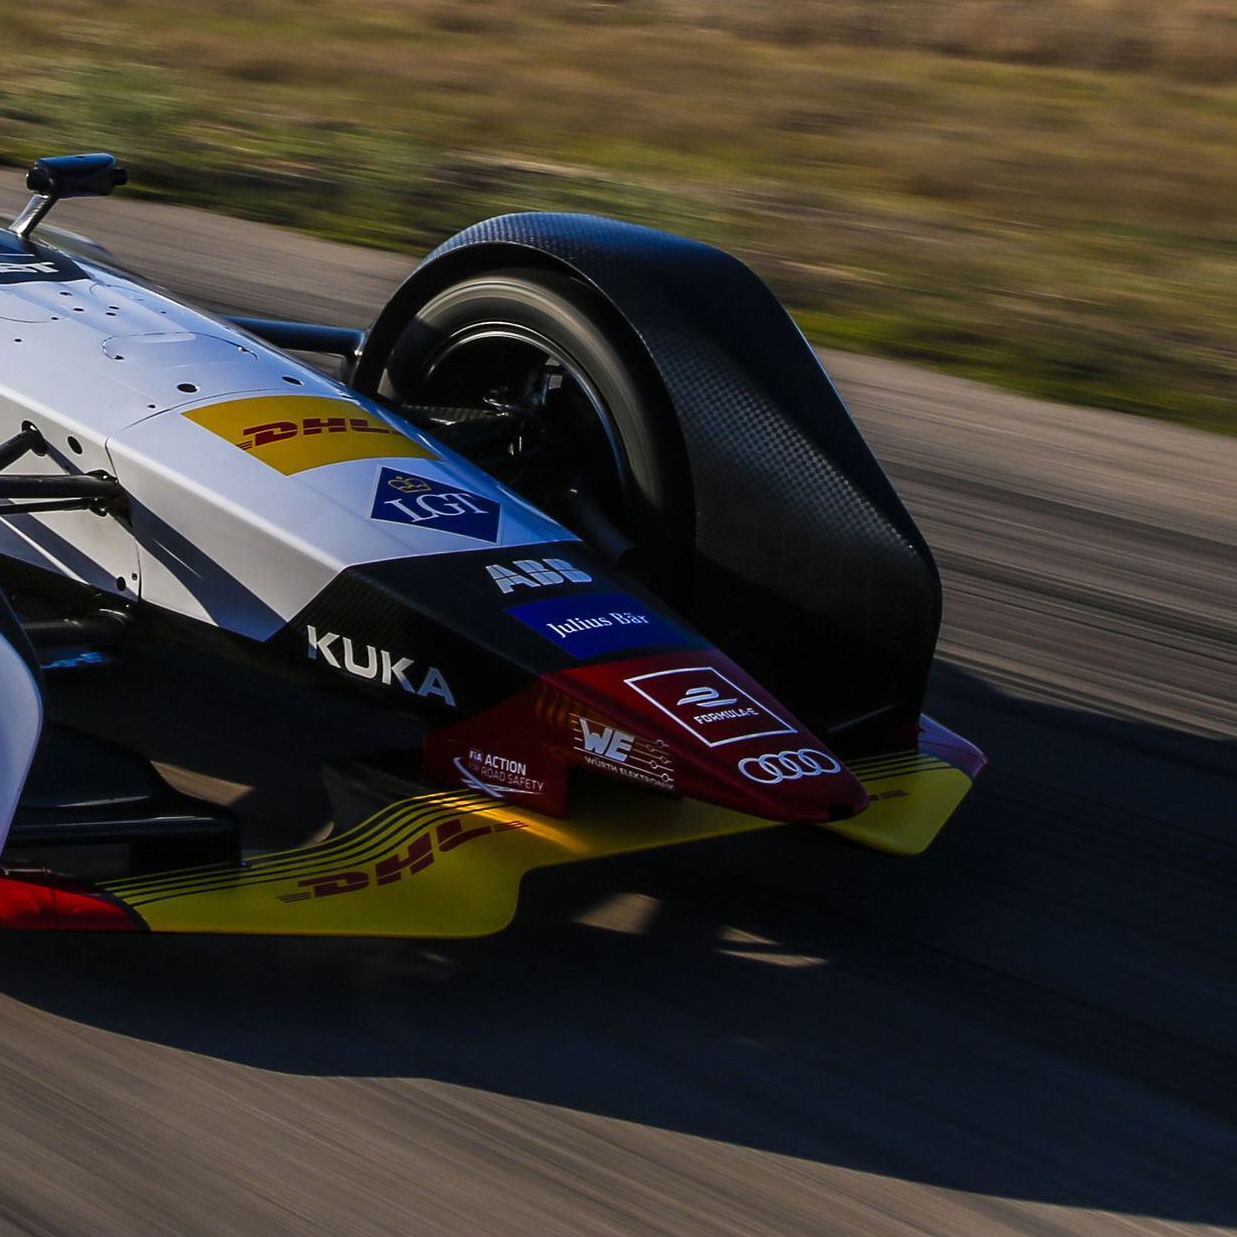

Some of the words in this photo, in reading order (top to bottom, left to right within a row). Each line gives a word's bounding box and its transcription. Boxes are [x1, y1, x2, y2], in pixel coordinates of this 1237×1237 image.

[242, 418, 391, 447] DHL
[384, 492, 490, 523] LGT
[485, 558, 593, 594] ABB
[546, 615, 613, 638] Julius
[609, 611, 650, 625] Bär
[306, 624, 457, 707] KUKA
[579, 717, 635, 762] WE
[469, 749, 482, 762] FIA
[484, 753, 526, 776] ACTION
[480, 766, 506, 782] ROAD
[506, 772, 544, 792] SAFETY
[297, 818, 493, 898] DHL
